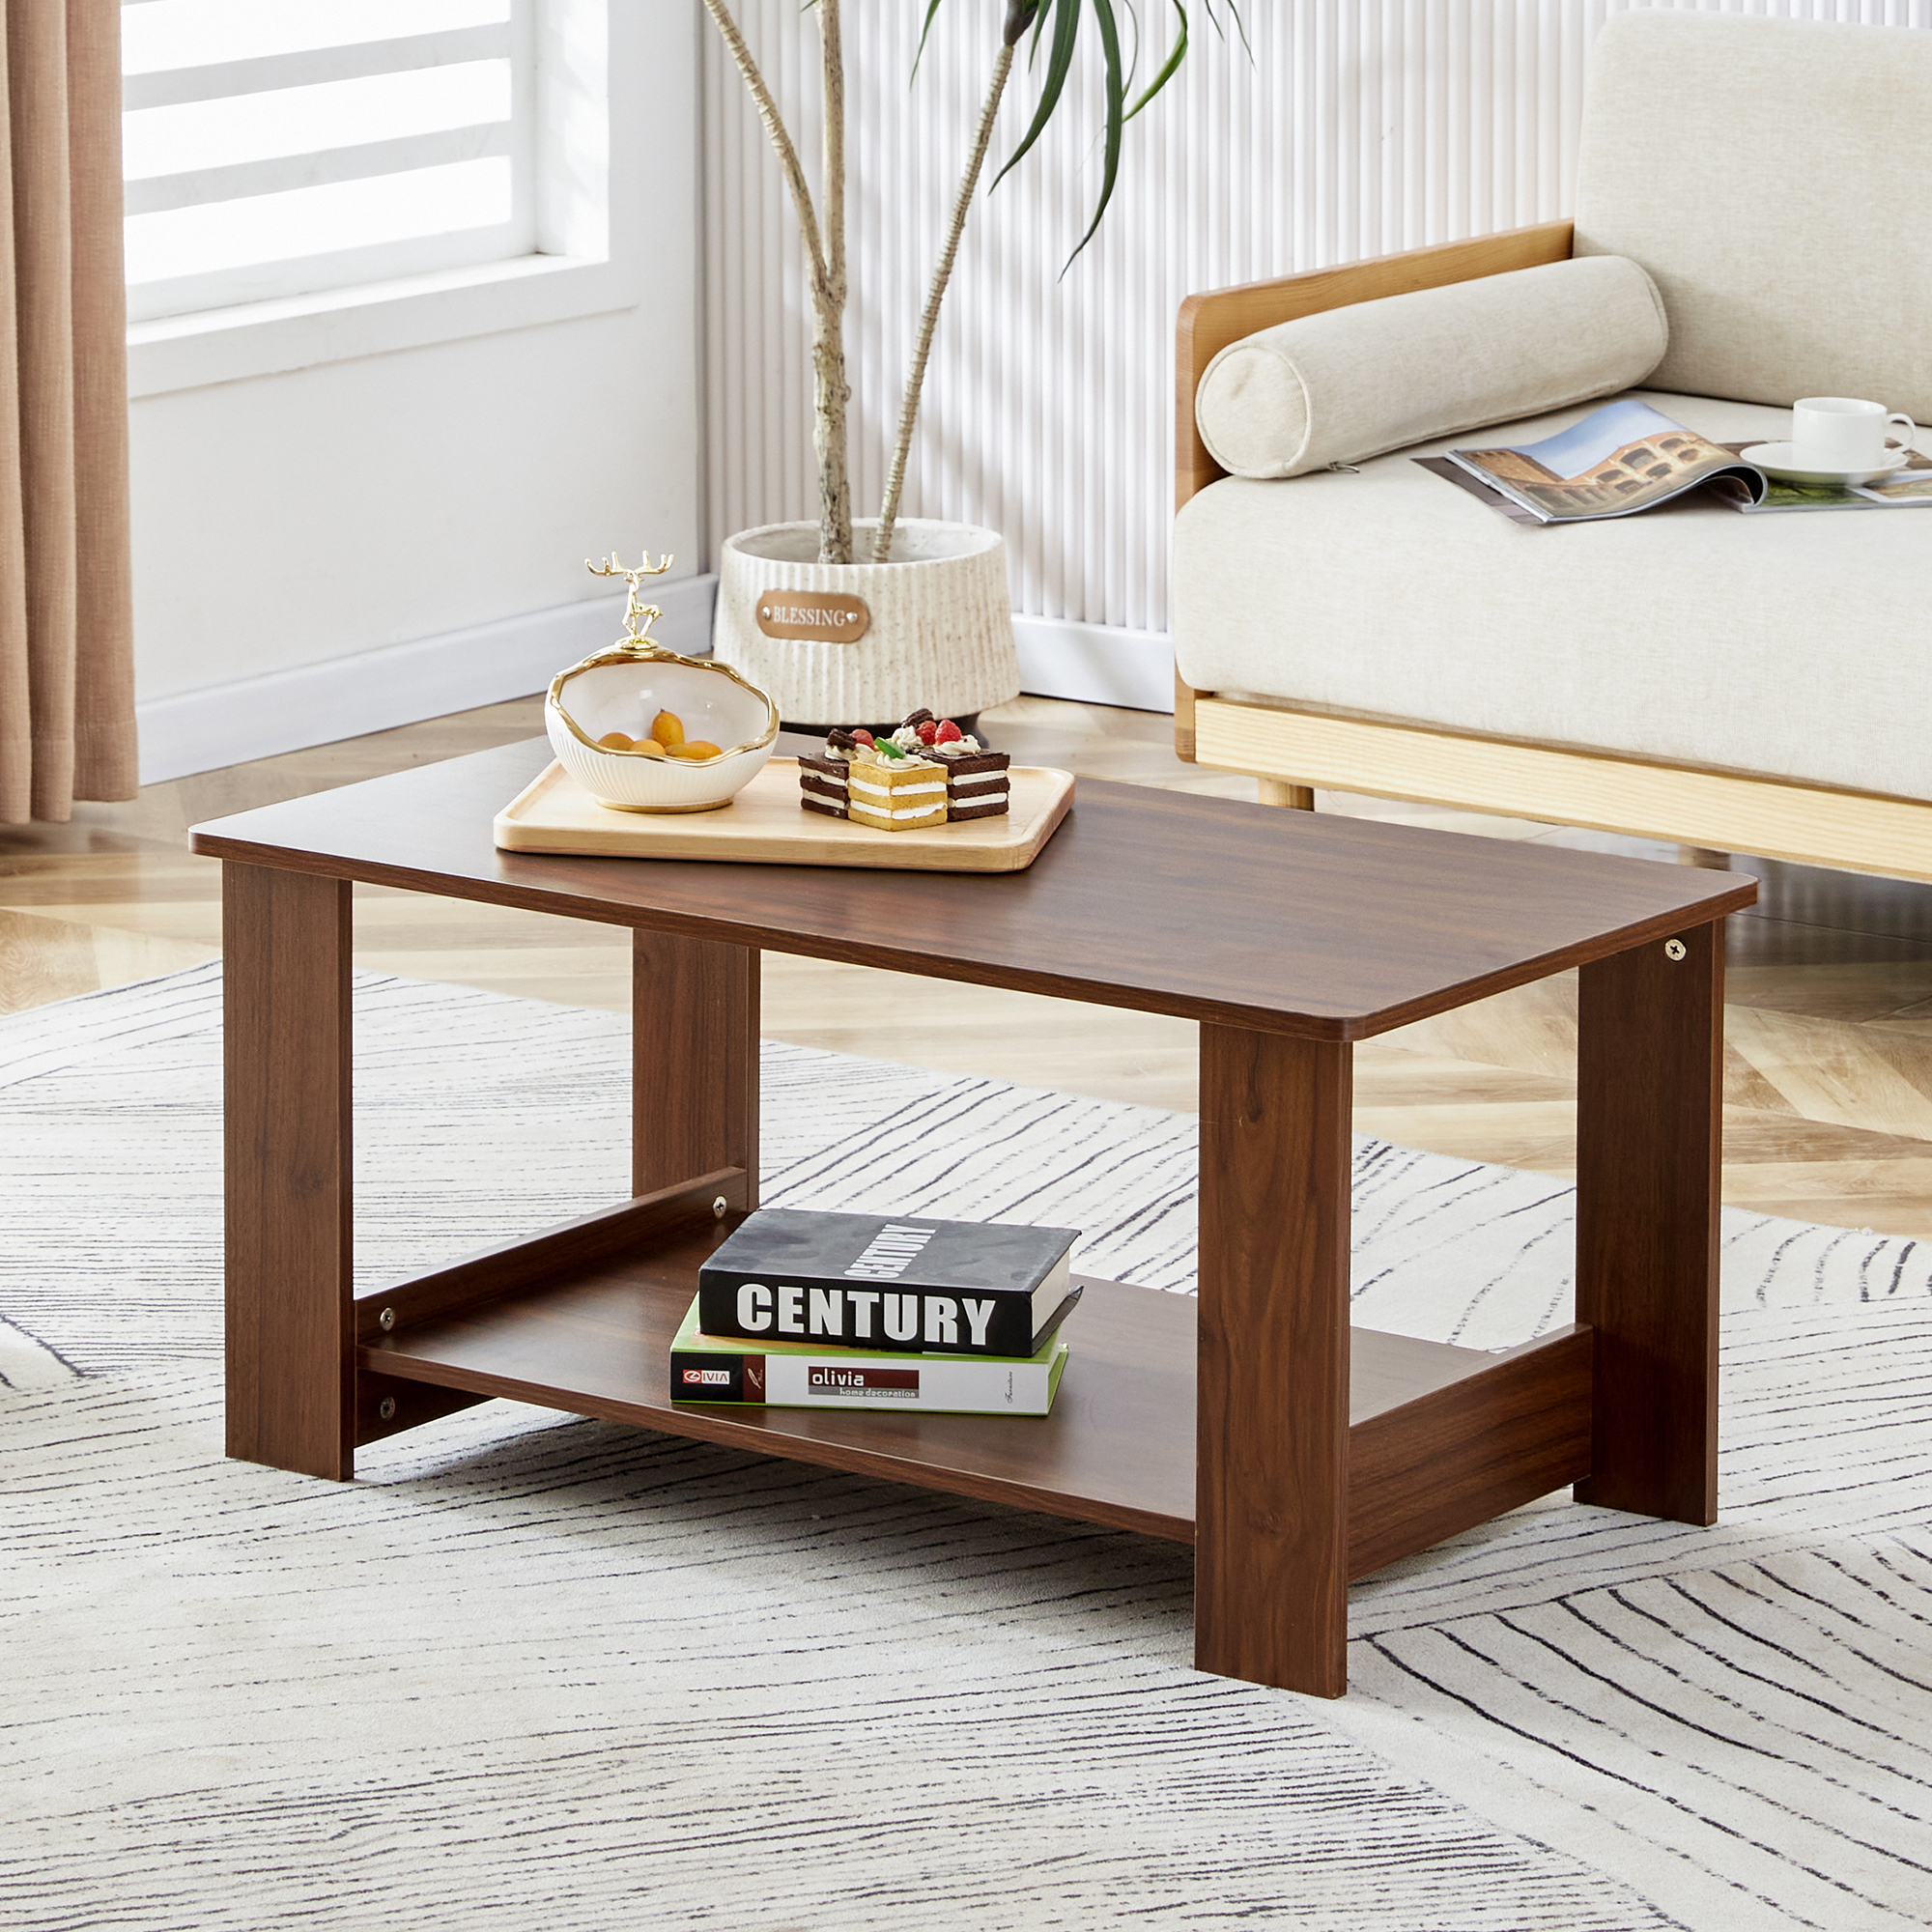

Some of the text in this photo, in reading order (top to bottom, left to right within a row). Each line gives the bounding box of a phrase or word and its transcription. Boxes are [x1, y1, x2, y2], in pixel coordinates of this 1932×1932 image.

[773, 606, 845, 627] BLESSING
[843, 1224, 937, 1279] CENTURY
[736, 1283, 997, 1346] CENTURY
[811, 1368, 865, 1386] olivia
